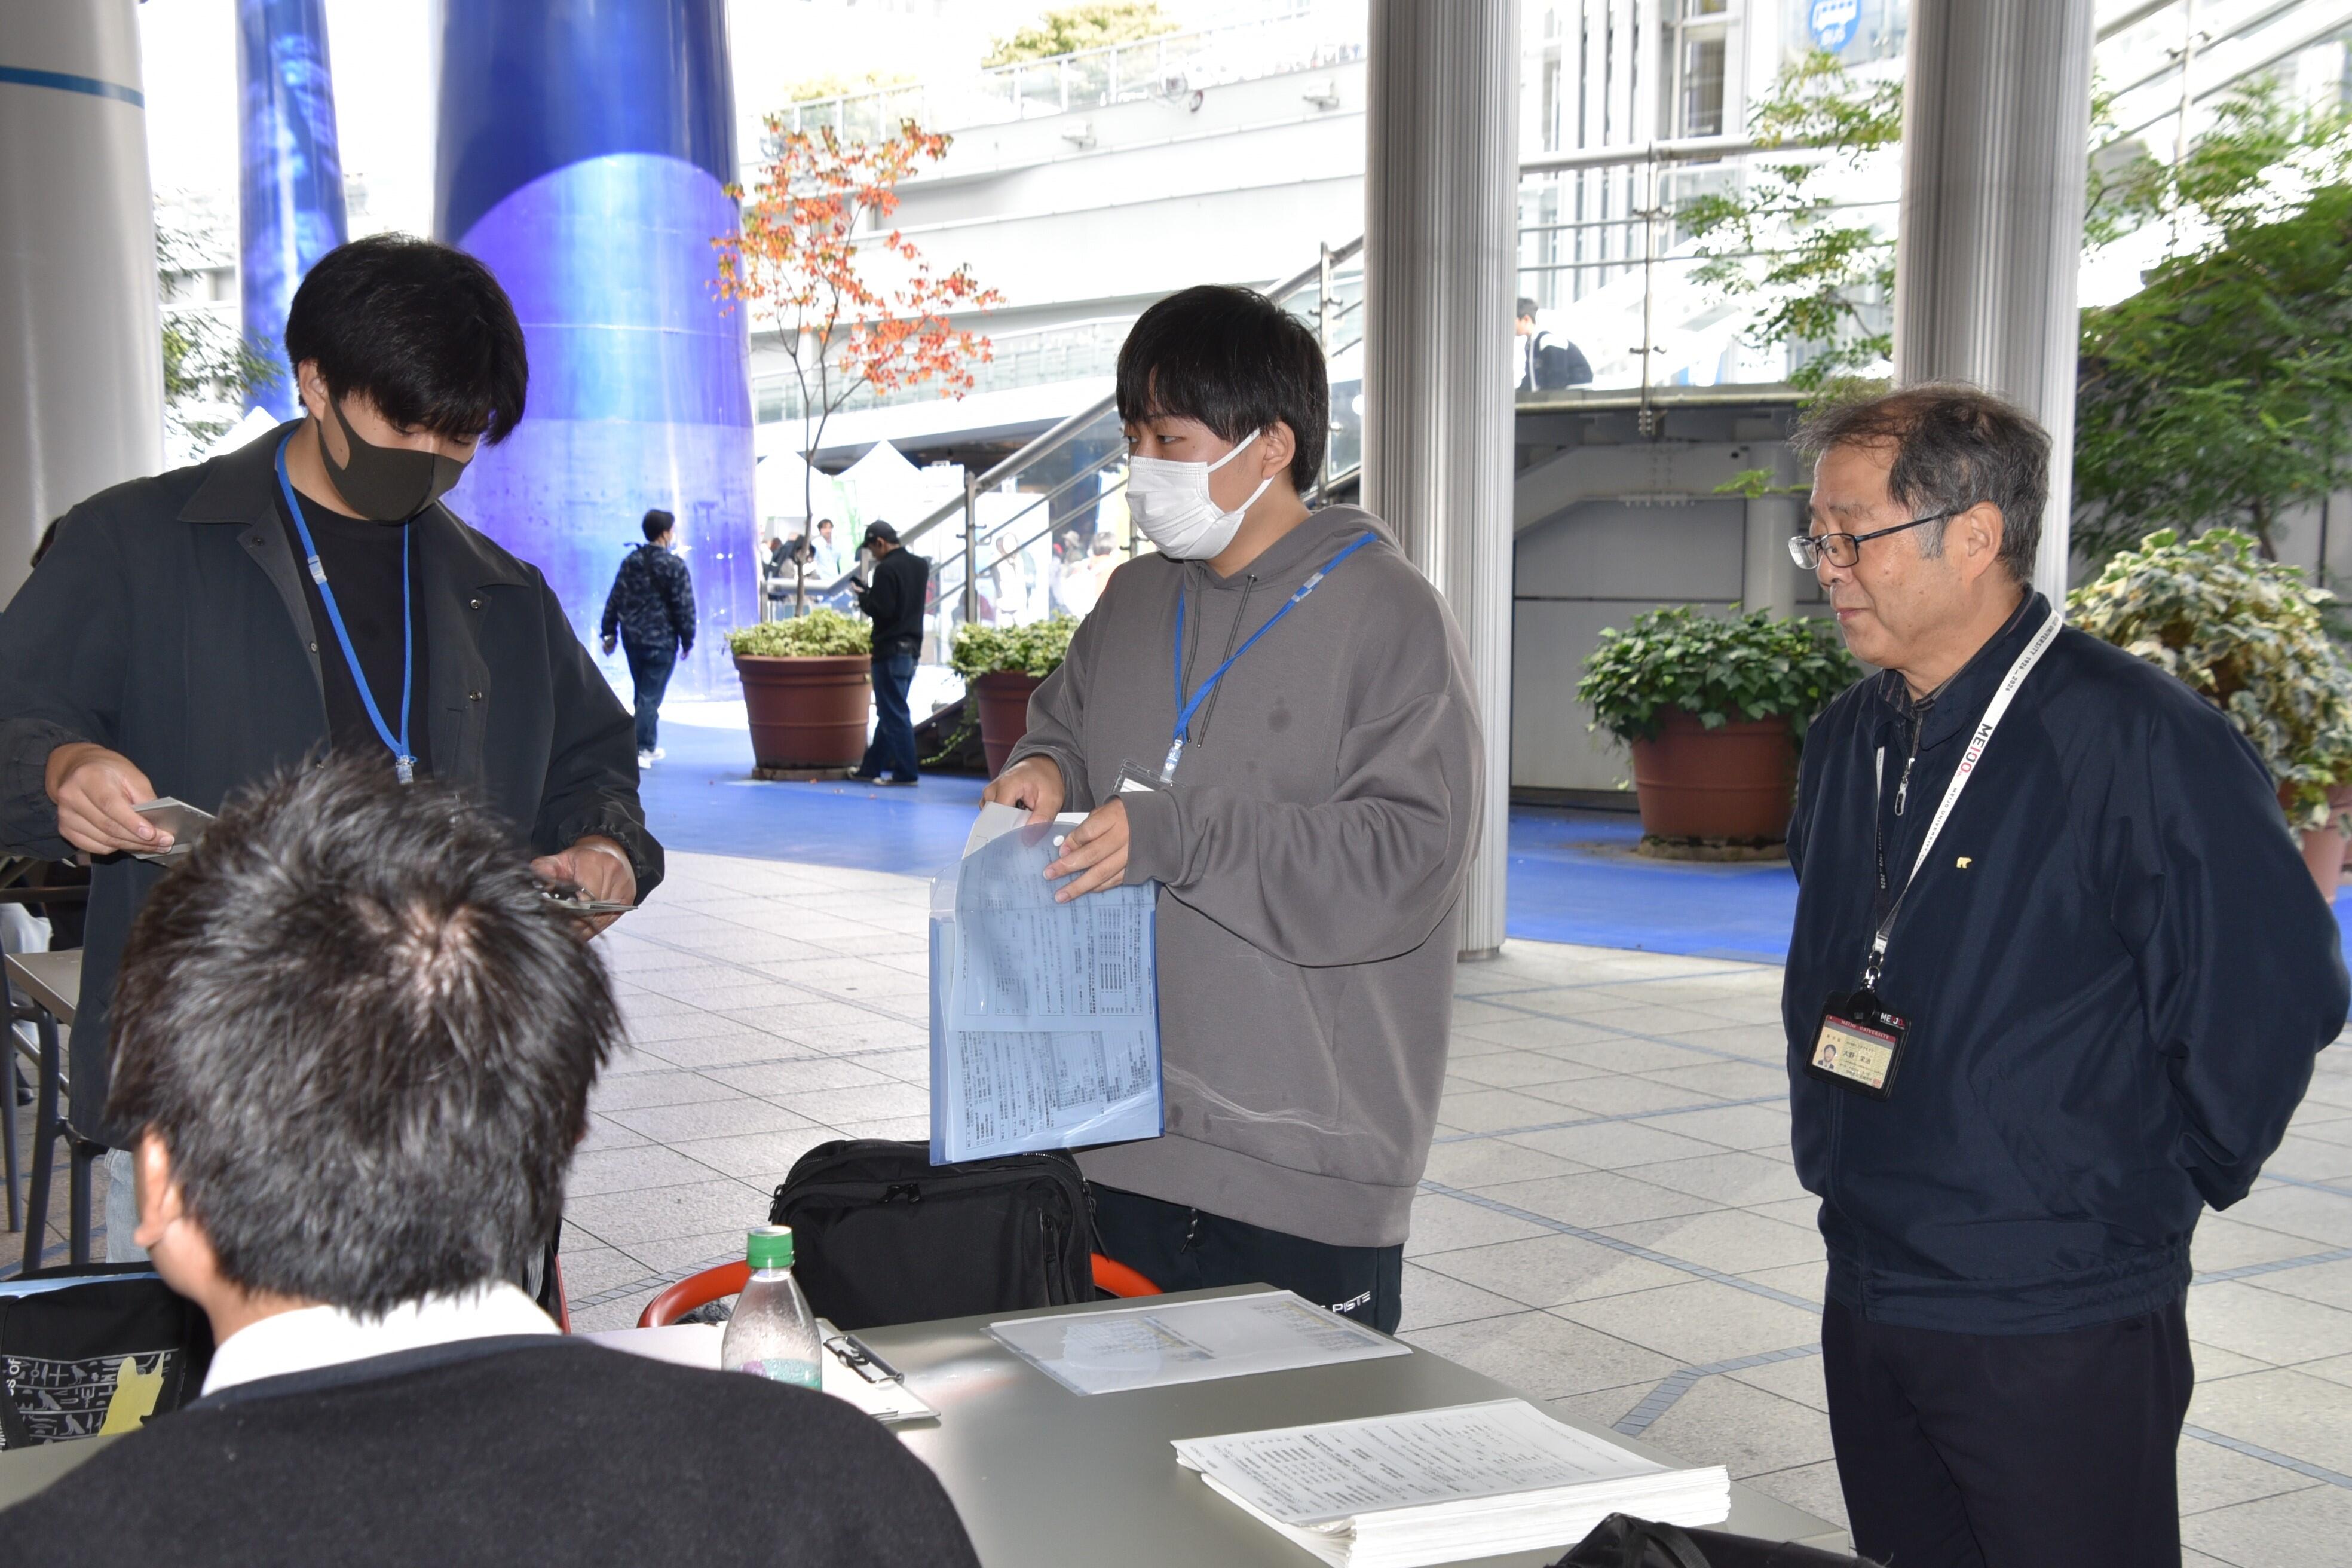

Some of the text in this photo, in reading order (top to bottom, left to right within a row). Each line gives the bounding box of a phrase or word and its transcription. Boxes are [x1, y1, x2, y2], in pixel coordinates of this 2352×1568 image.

[2019, 657, 2031, 670] 1926
[2005, 676, 2018, 691] 2026
[1945, 788, 1957, 808] MEIJO
[1924, 810, 1946, 852] UNIVERSITY
[1841, 1019, 1889, 1040] MEIJO UNIVERSITY
[1332, 1291, 1371, 1313] PISTE
[8, 1358, 22, 1374] of
